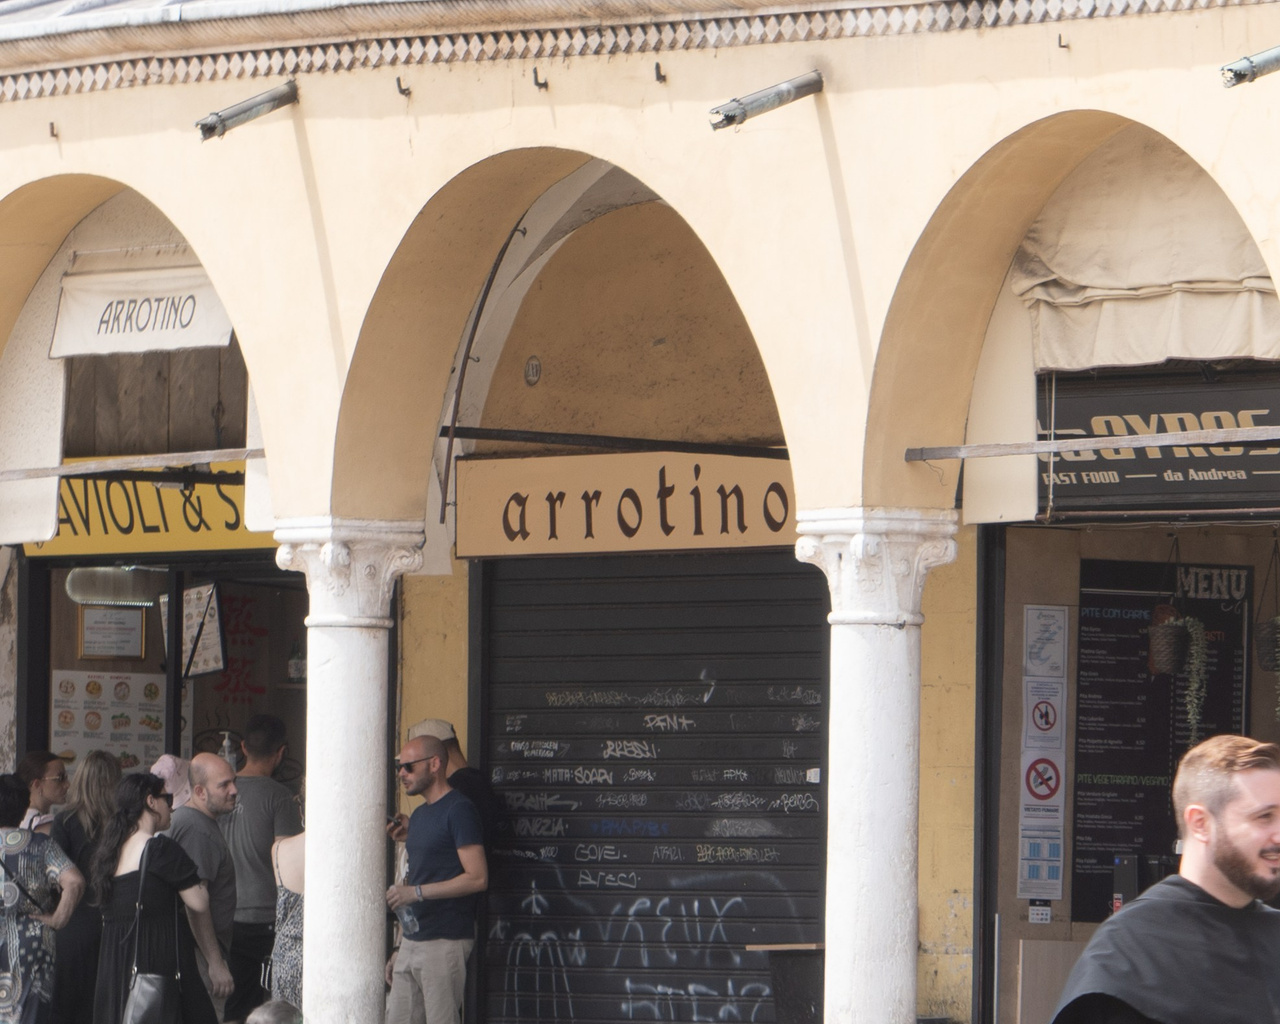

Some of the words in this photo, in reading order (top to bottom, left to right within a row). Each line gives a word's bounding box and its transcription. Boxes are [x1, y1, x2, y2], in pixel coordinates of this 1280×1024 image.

[96, 293, 197, 336] ARROTINO
[1041, 472, 1078, 485] FAST
[1081, 470, 1120, 484] FOOD
[1162, 469, 1184, 482] da
[1188, 468, 1248, 481] Andrea
[179, 488, 212, 533] &
[213, 469, 245, 532] S
[501, 462, 790, 543] arrotino
[1176, 566, 1248, 600] MENU
